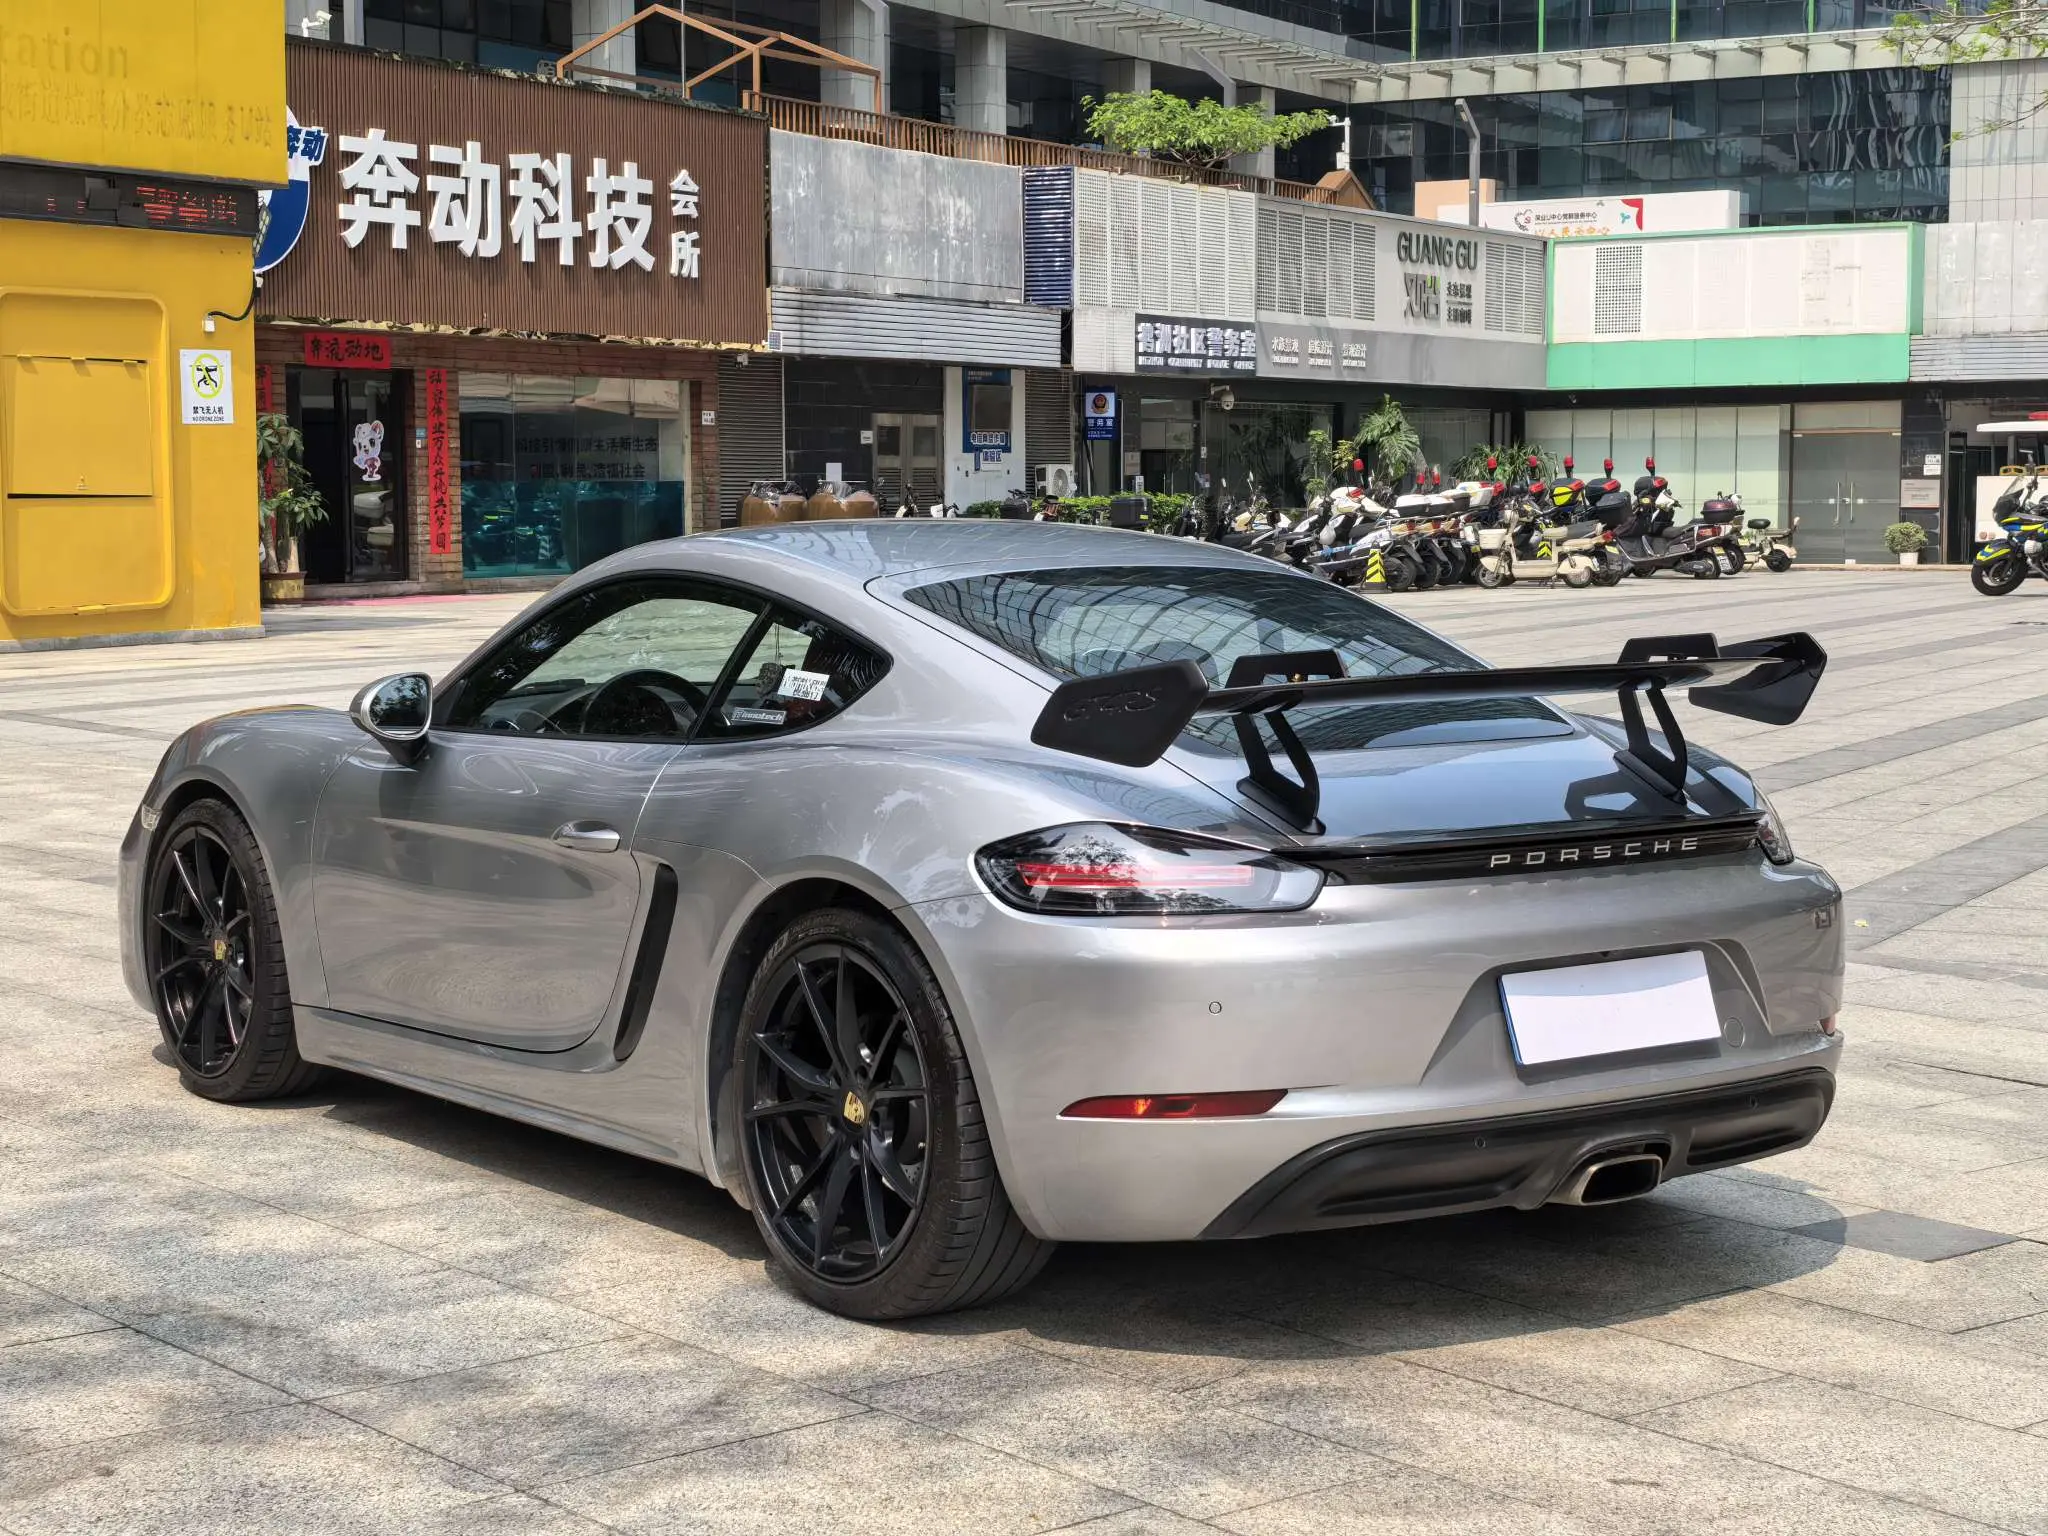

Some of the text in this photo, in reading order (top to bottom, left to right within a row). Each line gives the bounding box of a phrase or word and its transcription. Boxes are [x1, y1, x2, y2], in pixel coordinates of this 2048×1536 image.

[338, 128, 656, 272] 奔动科技
[670, 169, 700, 278] 会所
[1397, 231, 1478, 271] GUANG GU
[192, 406, 224, 415] 禁飞无人机
[1490, 837, 1698, 868] PORSCHE
